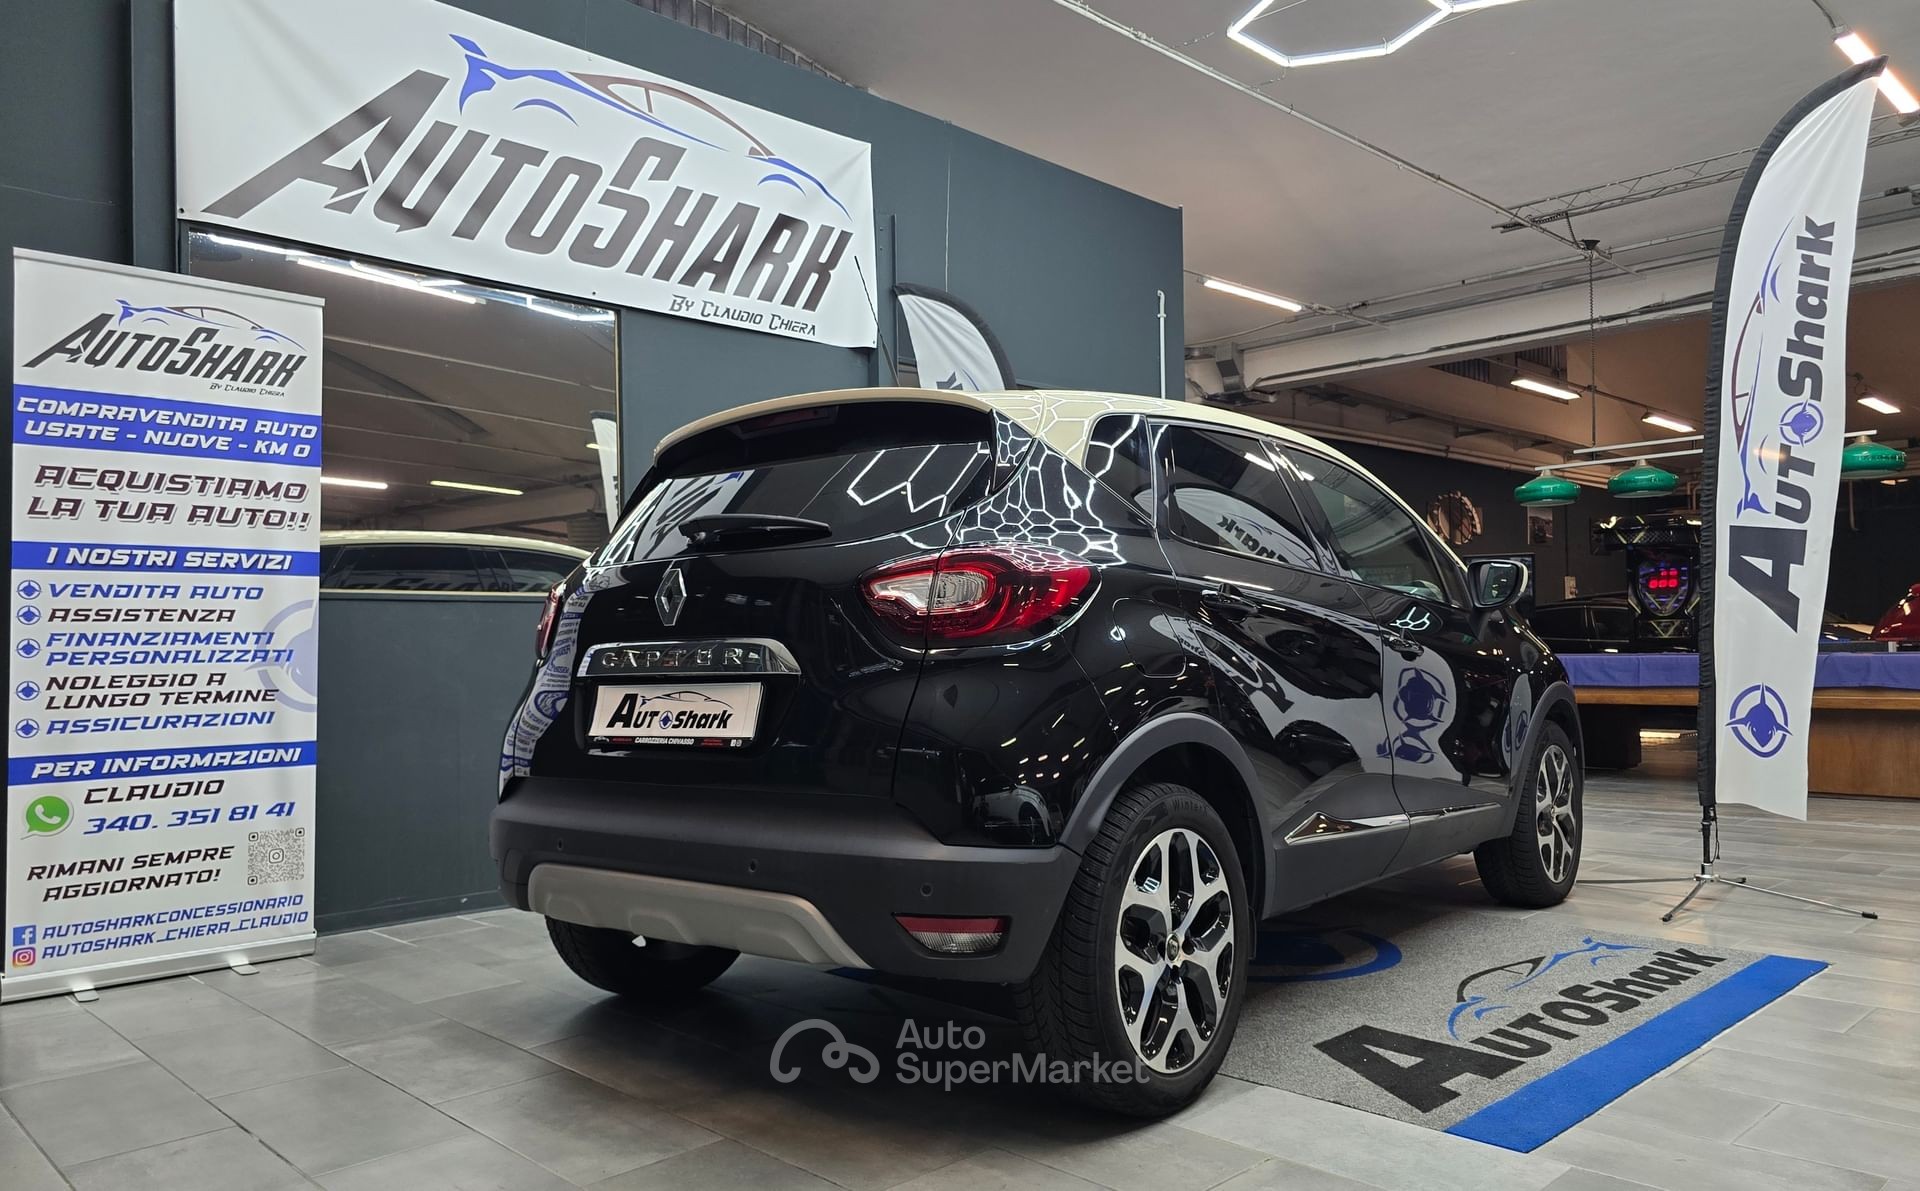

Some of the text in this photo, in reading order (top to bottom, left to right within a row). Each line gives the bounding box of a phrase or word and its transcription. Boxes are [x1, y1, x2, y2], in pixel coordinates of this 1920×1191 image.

[16, 396, 318, 439] COMPRAVENDITA AUTO
[24, 419, 119, 441] USATE
[143, 430, 233, 451] NUOVE
[253, 440, 289, 456] KM
[34, 464, 310, 501] ACQUISTIAMO
[27, 496, 311, 530] LA TUA AUTO!!
[46, 547, 292, 570] I NOSTRI SERVIZI
[49, 583, 264, 600] VENDITA AUTO
[48, 608, 236, 623] ASSISTENZA
[46, 632, 275, 647] FINANZIAMENTI
[46, 649, 294, 666] PERSONALIZZATI
[45, 672, 227, 691] NOLEGGIO A
[45, 689, 279, 710] LUNGO TERMINE
[46, 711, 276, 735] ASSICURAZIONI
[31, 747, 302, 779] PER INFORMAZIONI
[83, 779, 225, 804] CLAUDIO
[167, 808, 221, 827] 351
[228, 804, 259, 821] 81
[265, 801, 296, 817] 41
[27, 846, 236, 881] RIMANI SEMPRE
[43, 869, 221, 902] AGGIORNATO!
[42, 894, 304, 940] AUTOSHARKCONCESSIONARIO
